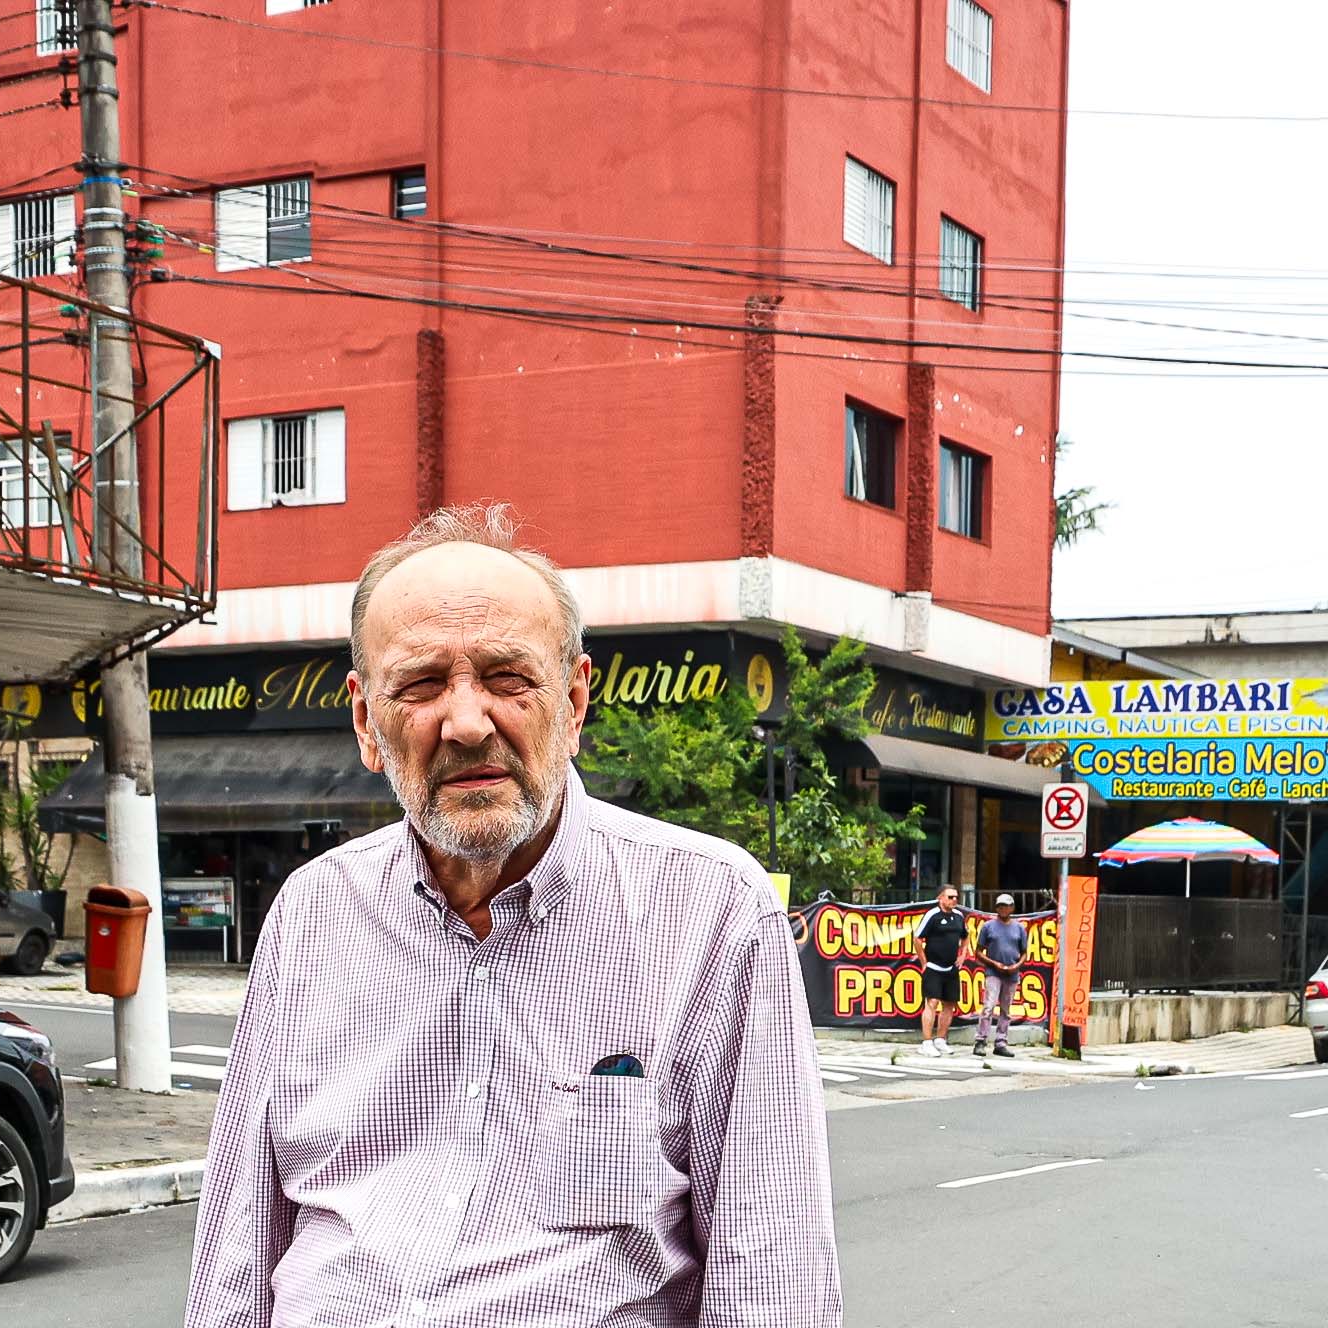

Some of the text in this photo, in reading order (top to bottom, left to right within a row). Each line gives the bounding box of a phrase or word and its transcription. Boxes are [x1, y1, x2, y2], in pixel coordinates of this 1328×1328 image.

[993, 681, 1291, 718] CASA LAMBARI
[1119, 714, 1221, 735] NÁUTICA
[1227, 718, 1241, 733] E
[1073, 743, 1236, 777] Costelaria
[1112, 778, 1215, 798] Restaurante
[1229, 777, 1267, 800] Café
[1072, 878, 1095, 1005] COBERTO
